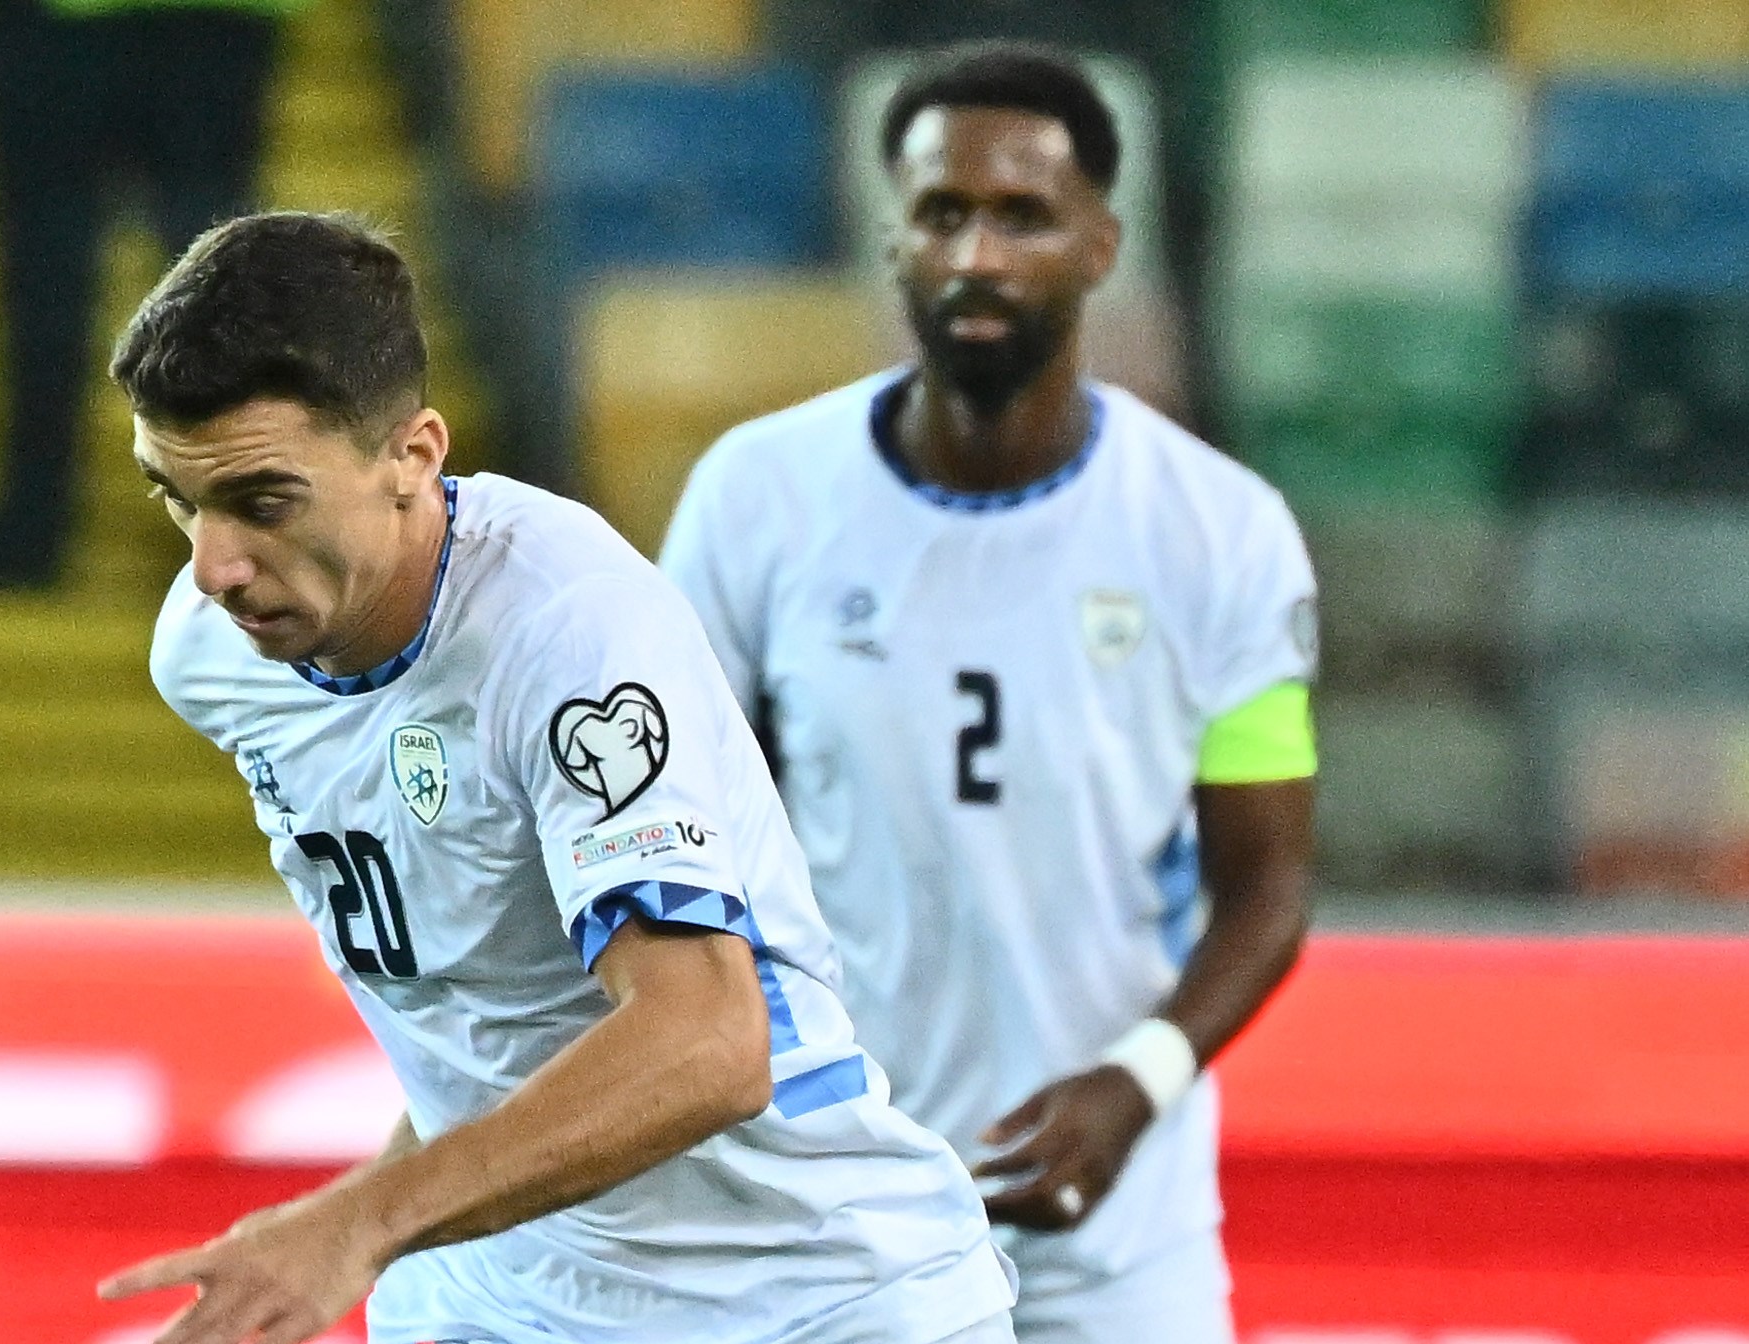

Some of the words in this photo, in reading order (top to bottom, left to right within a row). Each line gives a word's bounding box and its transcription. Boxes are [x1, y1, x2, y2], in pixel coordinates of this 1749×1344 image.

[400, 734, 437, 751] ISRAEL
[956, 671, 1002, 803] 2
[573, 827, 674, 865] FOUNDATION
[295, 830, 420, 979] 20
